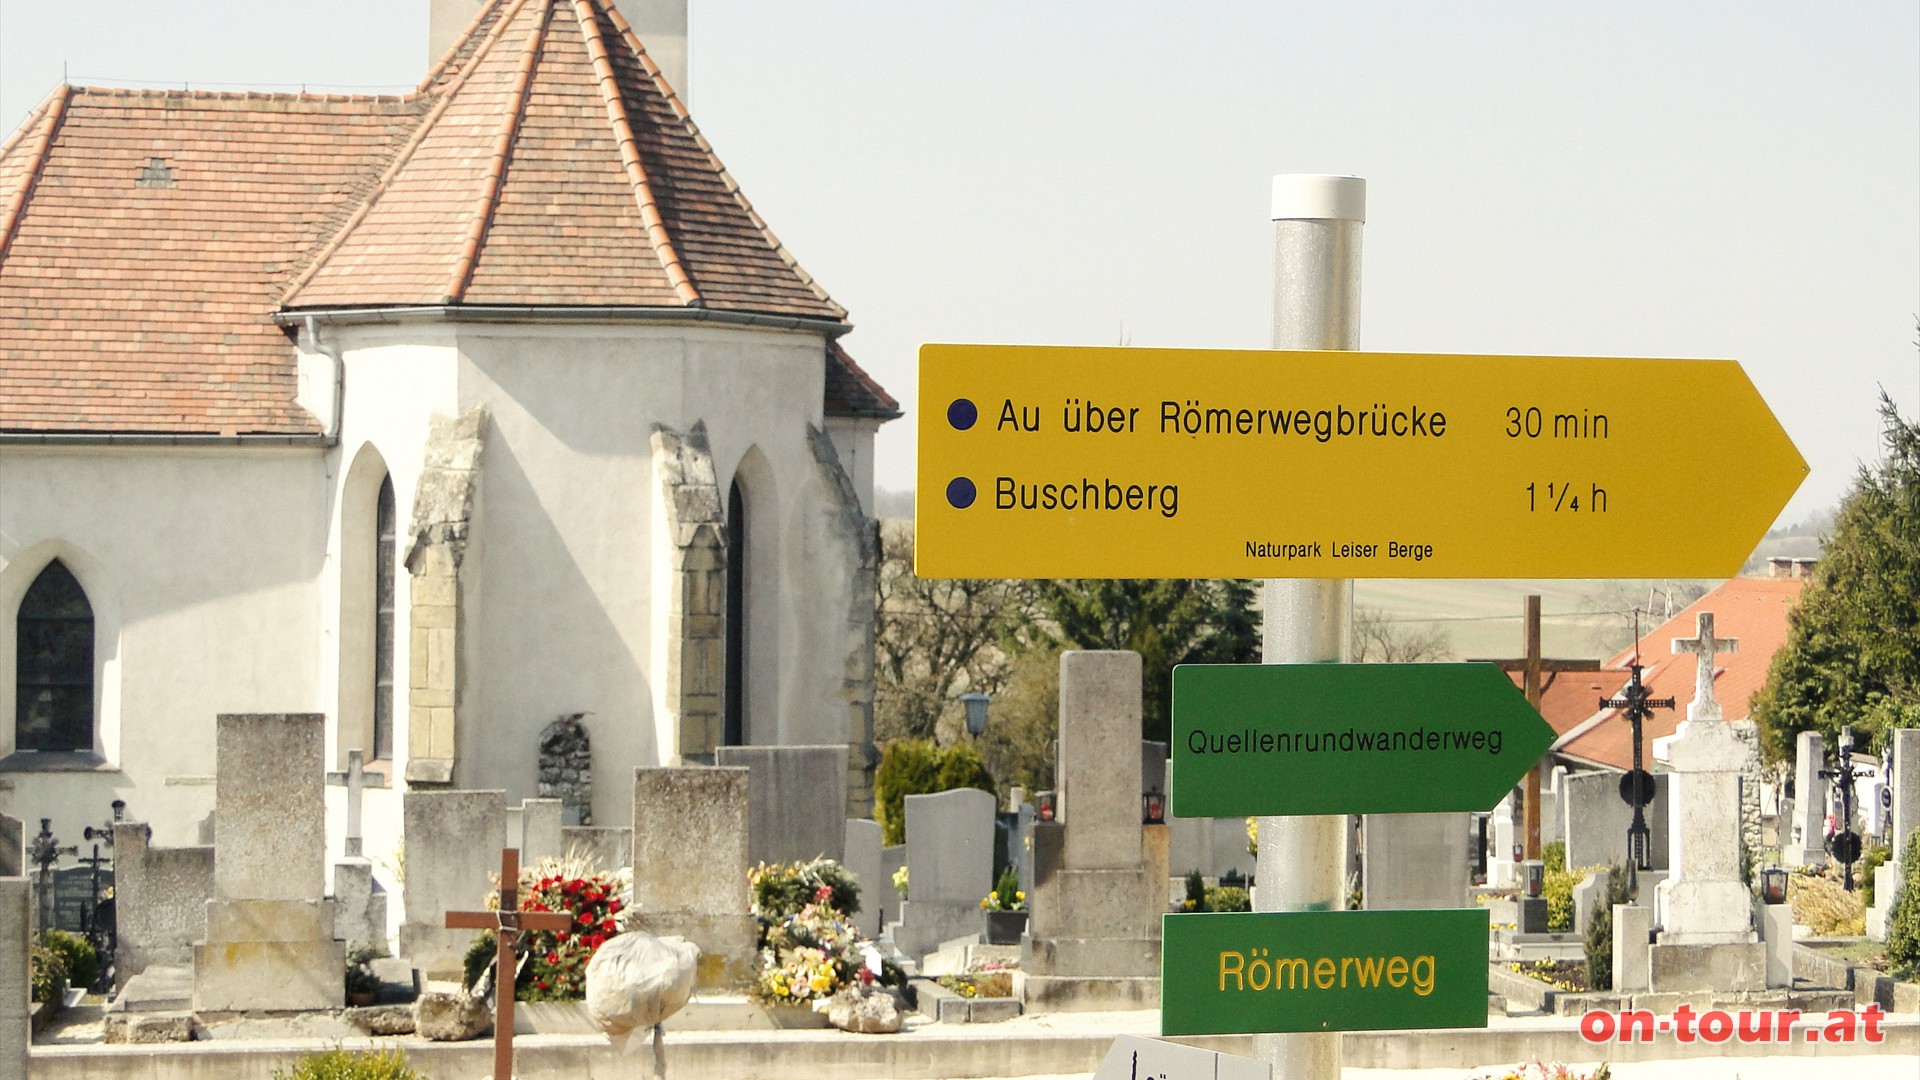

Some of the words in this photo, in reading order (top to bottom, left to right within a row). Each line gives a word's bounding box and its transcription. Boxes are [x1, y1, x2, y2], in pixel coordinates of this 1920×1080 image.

[998, 398, 1040, 432] Au
[1064, 398, 1140, 434] über
[1161, 400, 1447, 443] Römerwegbrücke
[1505, 406, 1542, 438] 30
[1554, 408, 1608, 439] min
[996, 476, 1178, 518] Buschberg
[1591, 482, 1607, 513] h
[1245, 540, 1322, 561] Naturpark
[1332, 541, 1379, 558] Leiser
[1388, 541, 1433, 562] Berge
[1188, 726, 1502, 756] Quellenrundwanderweg
[1217, 947, 1436, 996] Römerweg
